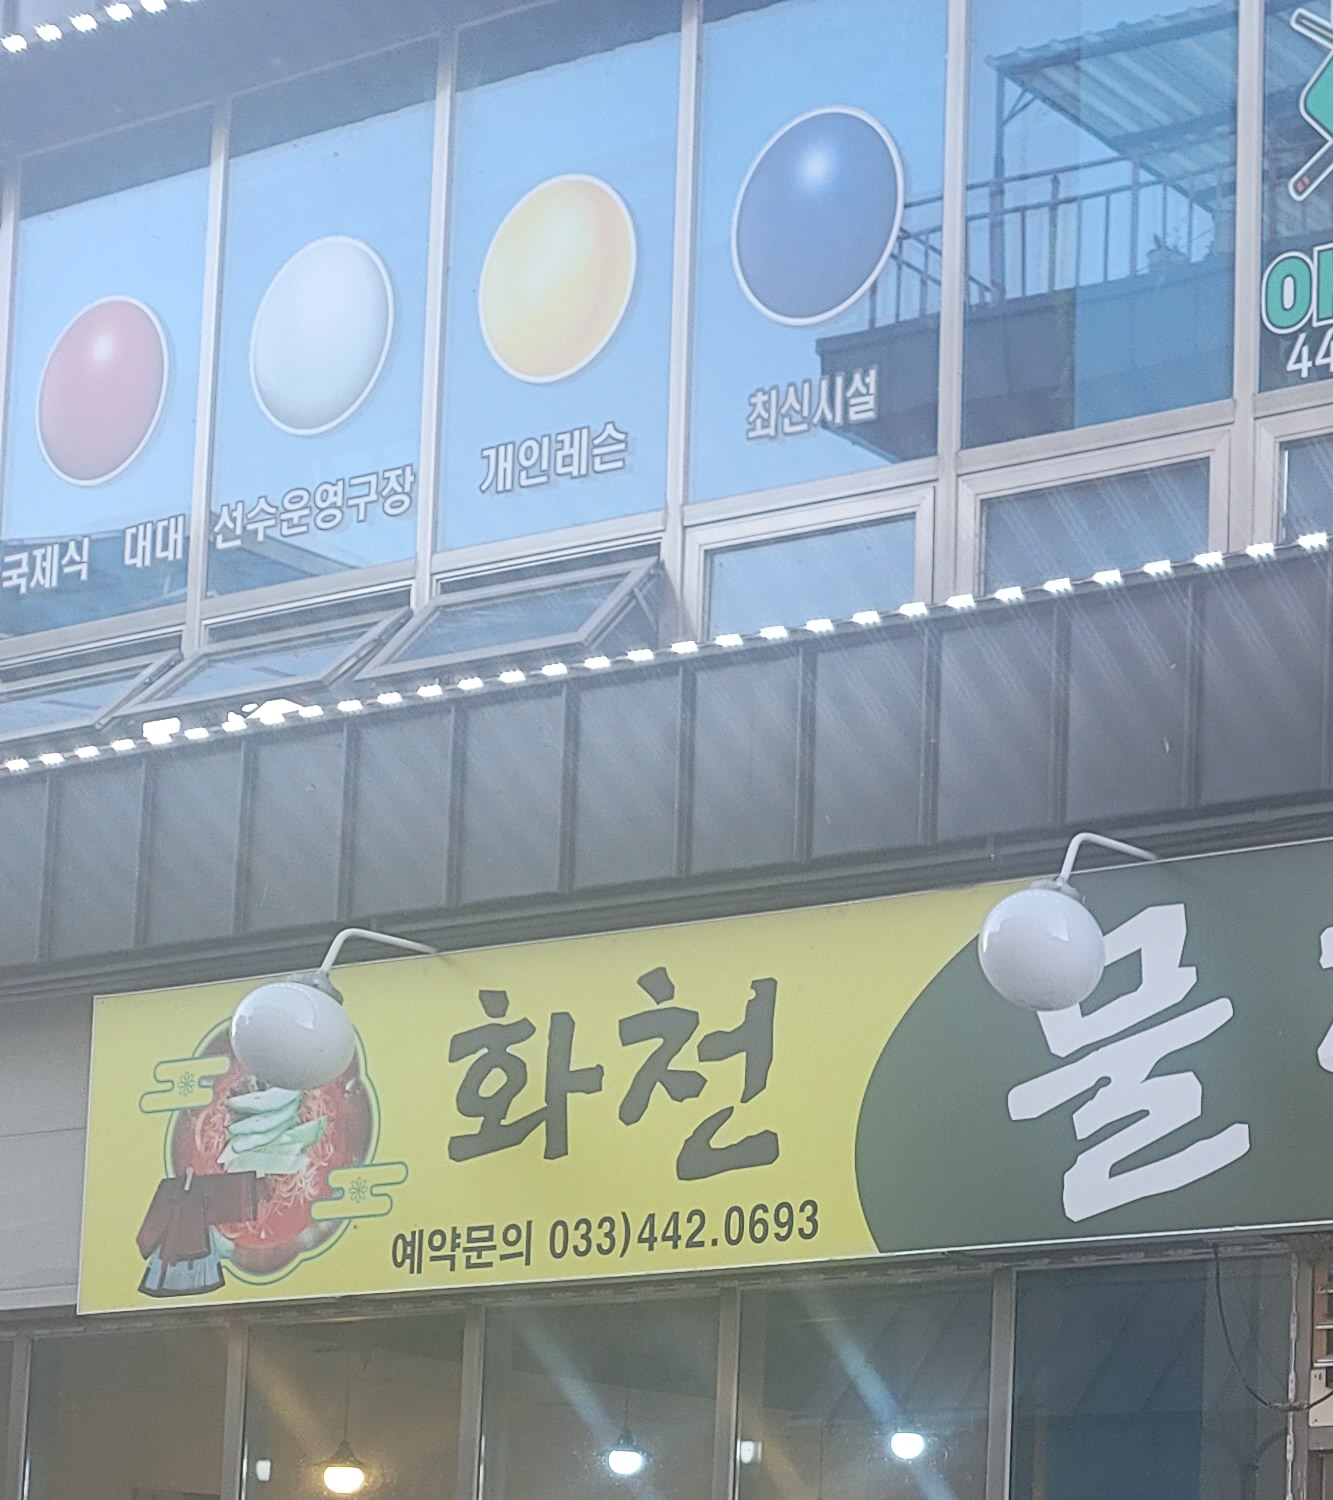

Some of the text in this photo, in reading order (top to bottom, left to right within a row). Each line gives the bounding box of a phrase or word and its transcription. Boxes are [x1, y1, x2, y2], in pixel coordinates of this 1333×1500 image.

[746, 368, 879, 441] 최신시설
[480, 423, 628, 495] 개인레슨
[213, 465, 416, 550] 선수운영구장
[1, 514, 185, 594] 국제식 대대
[447, 966, 779, 1181] 화천
[391, 1199, 820, 1277] 예약문의 033)442.0693
